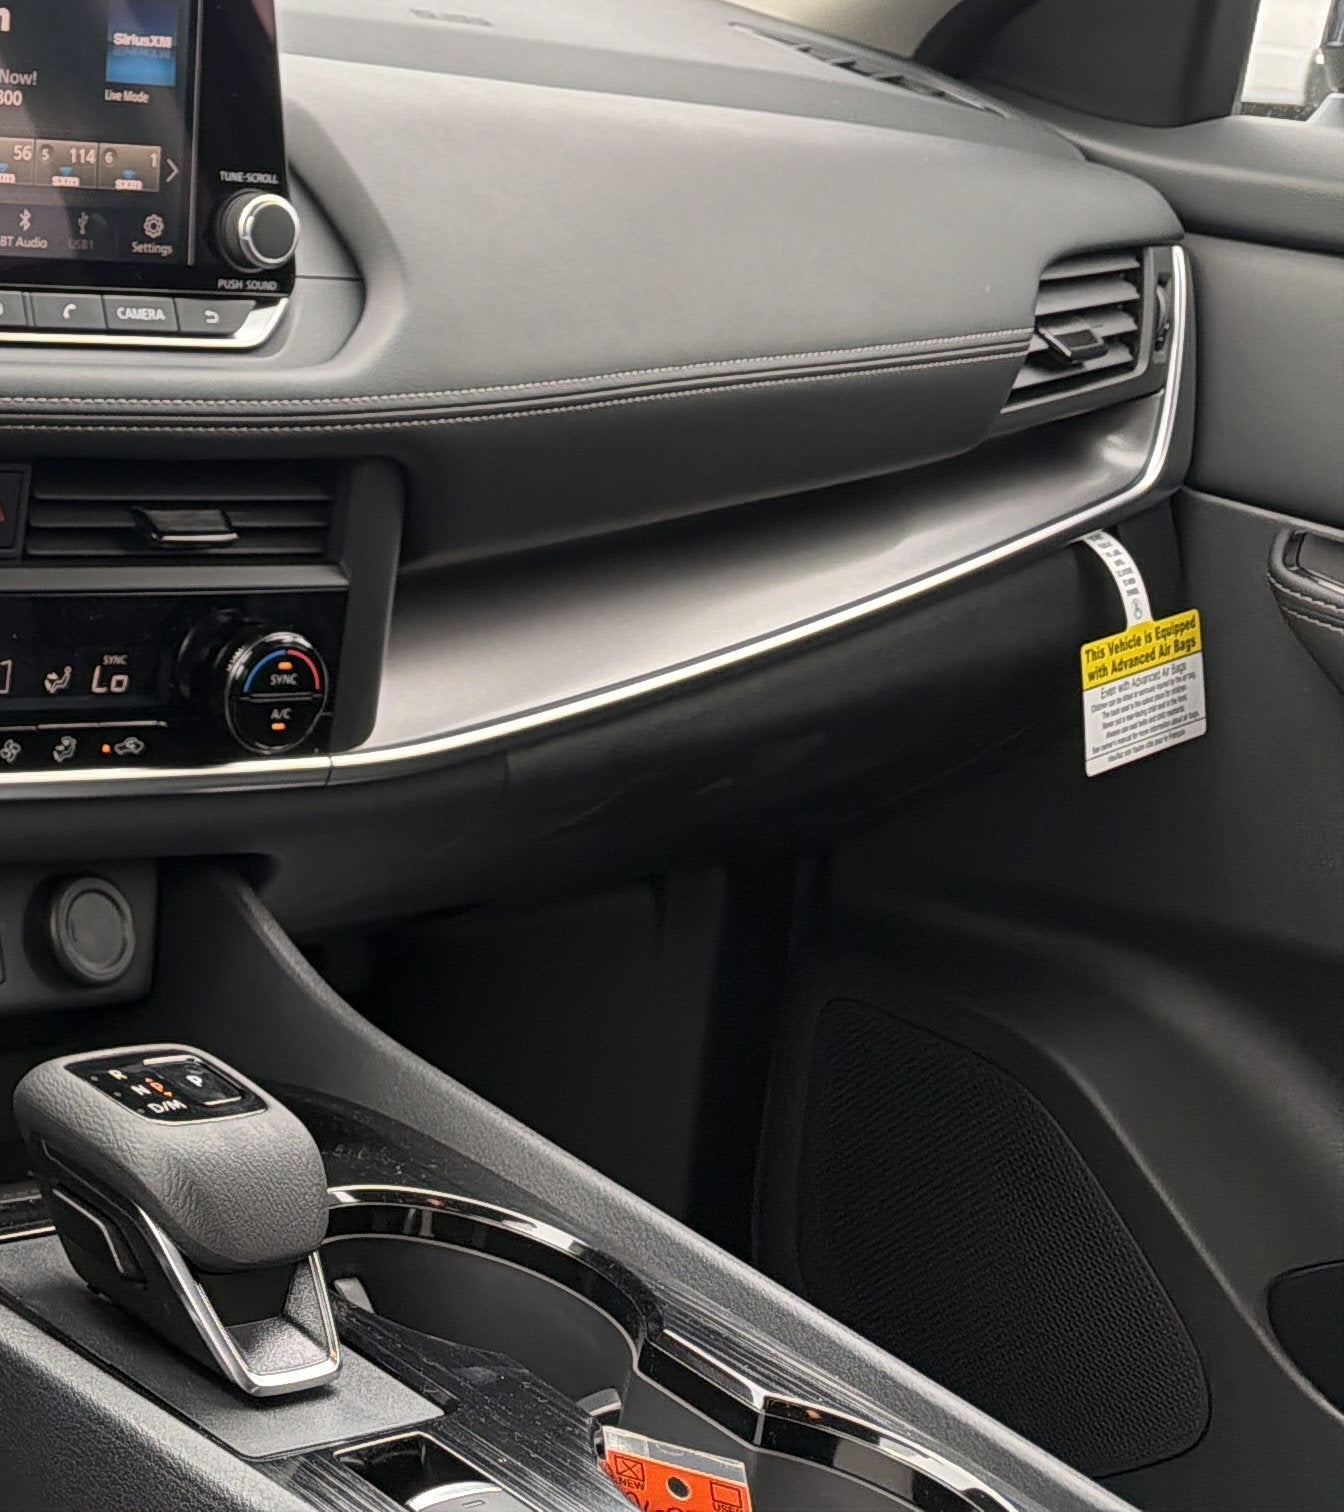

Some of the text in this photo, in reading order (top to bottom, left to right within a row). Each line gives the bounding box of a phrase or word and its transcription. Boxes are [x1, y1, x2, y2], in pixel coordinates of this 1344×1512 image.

[123, 90, 150, 104] Mode
[13, 144, 33, 162] 56
[41, 147, 97, 165] 5 114
[104, 151, 158, 168] 6 1
[0, 235, 49, 250] BT Audio
[131, 240, 174, 257] Settings
[217, 278, 278, 291] PUSH SOUND
[116, 306, 166, 321] CAMERA
[1085, 613, 1197, 665] This Vehicle is Equipped
[102, 653, 129, 666] SYNC
[1087, 636, 1197, 683] with Advanced Air Bags
[91, 664, 129, 694] Lo
[269, 672, 299, 687] SYNC
[270, 707, 293, 720] A/C
[108, 1069, 128, 1081] R
[186, 1075, 203, 1087] P
[130, 1084, 152, 1097] N
[147, 1099, 187, 1114] D/M
[618, 1478, 645, 1490] NEW
